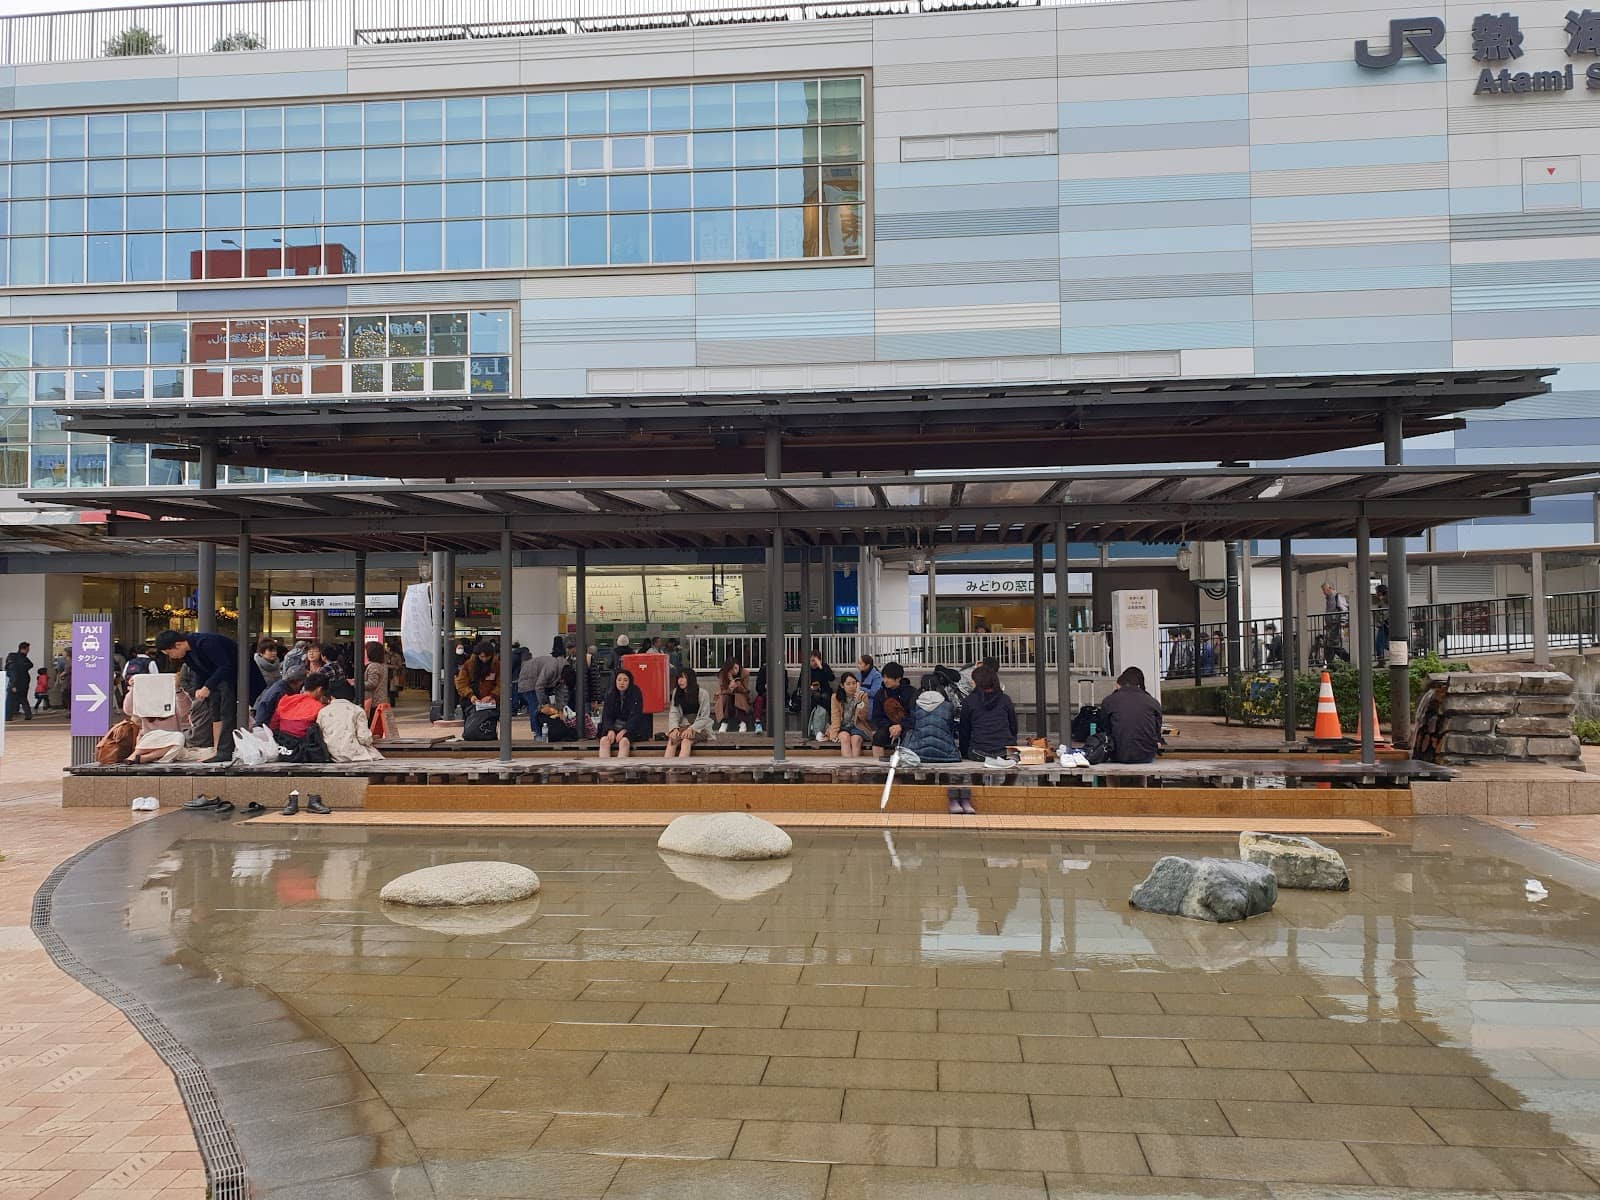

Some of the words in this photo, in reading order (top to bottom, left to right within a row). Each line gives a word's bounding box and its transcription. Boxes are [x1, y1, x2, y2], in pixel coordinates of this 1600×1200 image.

[1355, 16, 1447, 69] JR
[1473, 64, 1574, 95] Atami
[282, 599, 296, 607] JR
[80, 625, 103, 634] TAXI
[78, 654, 105, 662] タクシー
